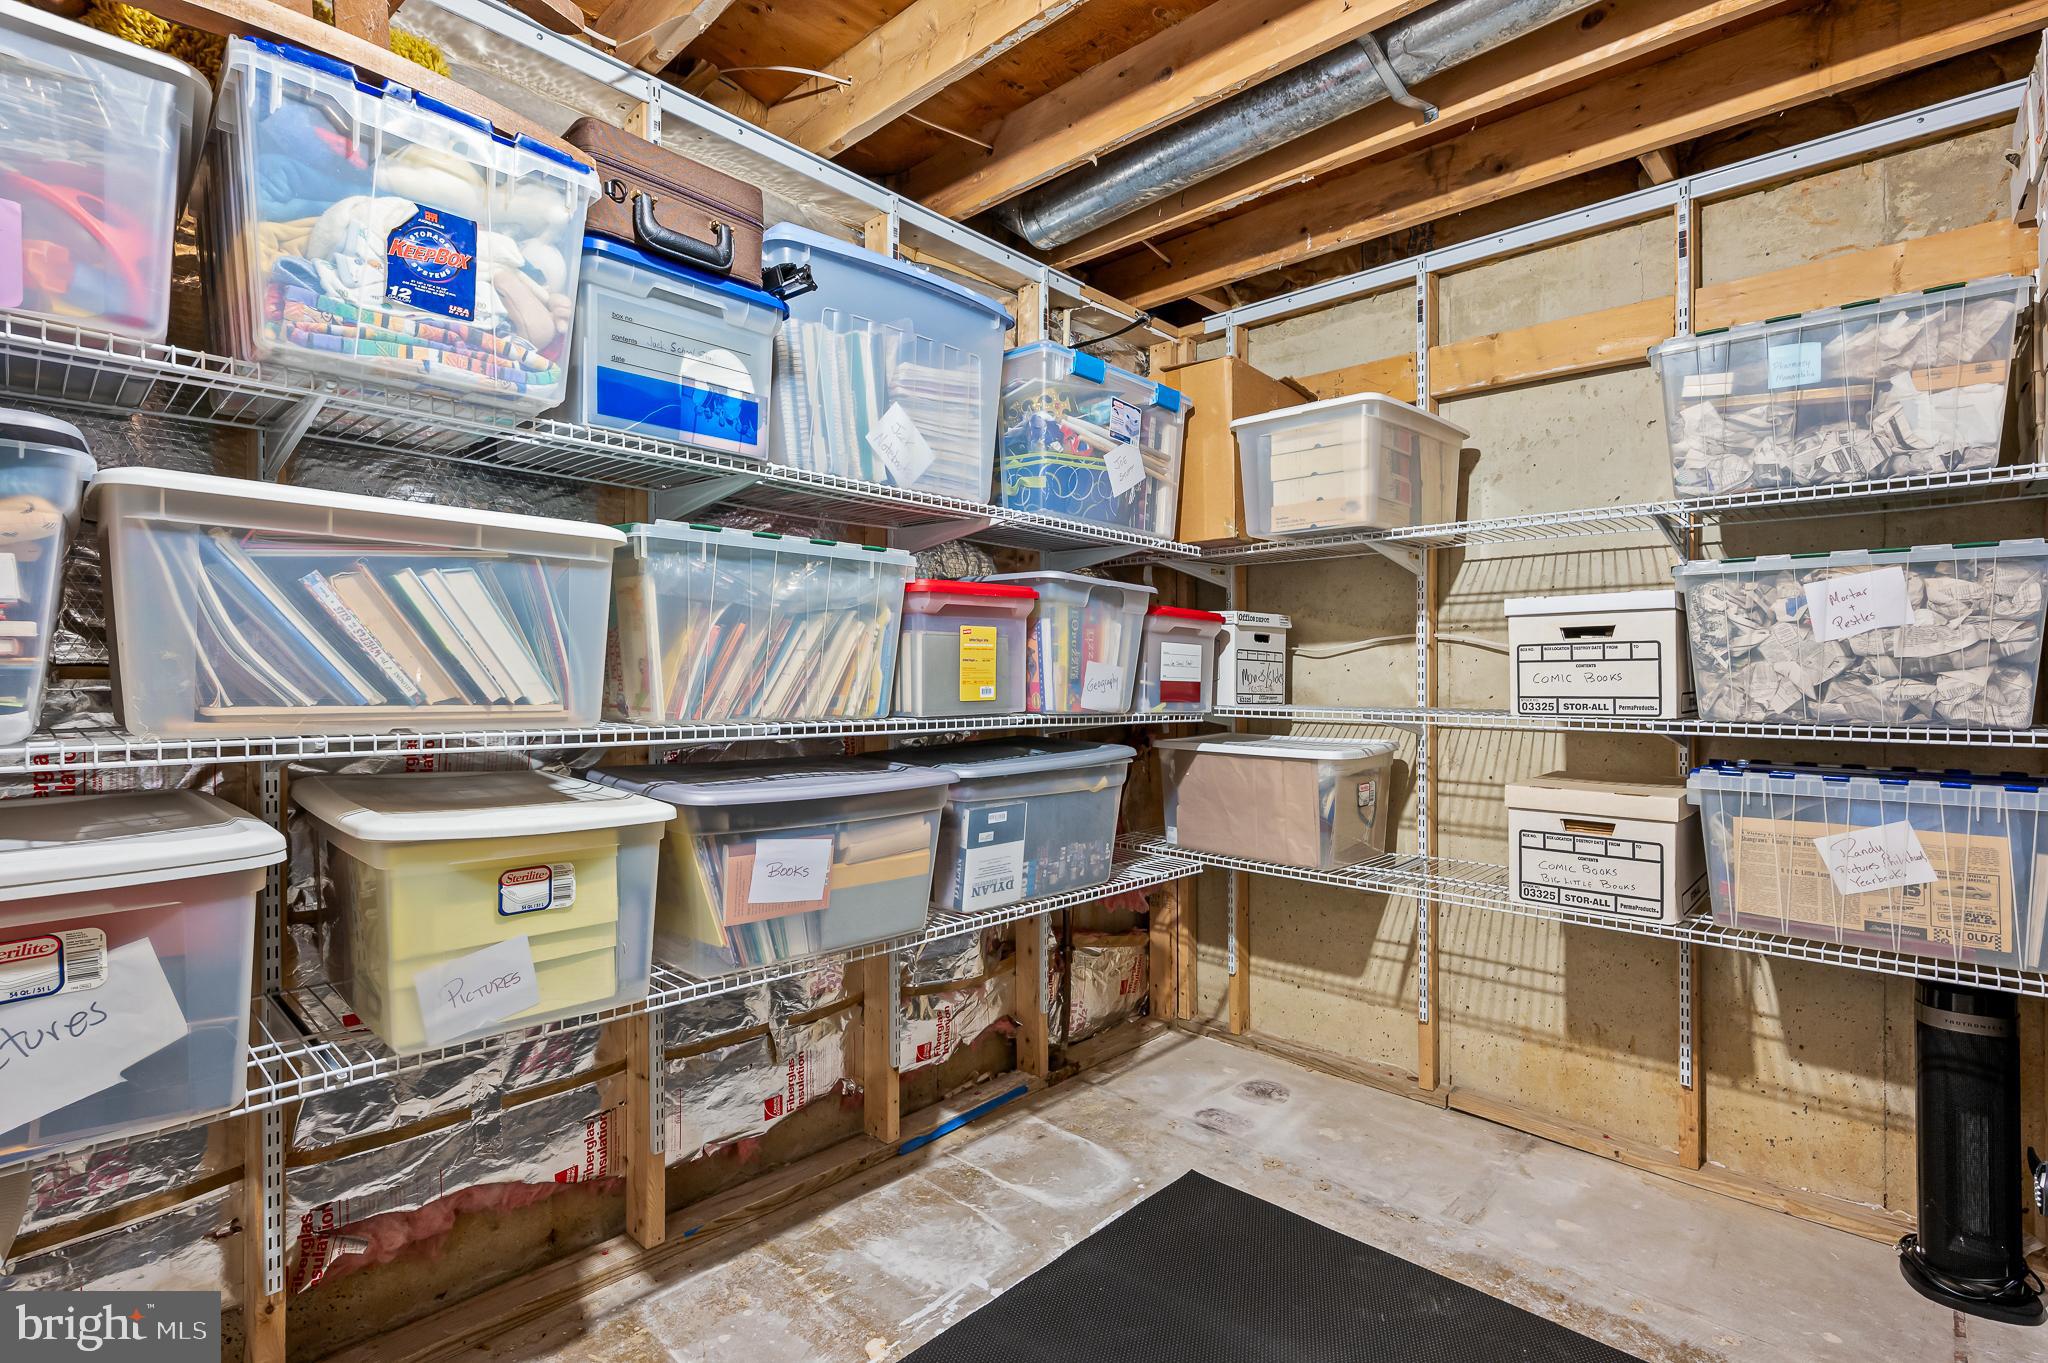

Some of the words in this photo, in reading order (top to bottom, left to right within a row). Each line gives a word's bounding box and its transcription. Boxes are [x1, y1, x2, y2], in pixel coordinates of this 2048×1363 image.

[409, 231, 451, 248] STORAGE
[411, 262, 452, 278] SYSTEMS
[389, 286, 412, 299] 12
[449, 305, 470, 315] USA
[611, 311, 624, 320] box
[611, 334, 638, 345] contents
[611, 355, 626, 363] date
[1828, 587, 1868, 606] Mortar
[1239, 613, 1256, 622] Office
[1832, 611, 1876, 630] Pestles
[1521, 702, 1555, 711] 03325
[1563, 703, 1610, 711] STOR-ALL
[1830, 838, 1886, 860] Randy
[506, 870, 544, 884] Sterilite
[1540, 873, 1561, 883] BIG
[1564, 877, 1592, 888] LITTLE
[971, 878, 1015, 898] DYLAN
[1523, 887, 1556, 901] 03325
[1564, 894, 1611, 908] STOR-ALL
[1967, 932, 1994, 943] OLDS
[10, 991, 18, 999] 54
[933, 1010, 944, 1057] Fiberglas
[786, 1058, 797, 1113] Fiberglas
[582, 1120, 597, 1184] Fiberglas
[291, 1213, 314, 1294] Fiberglas
